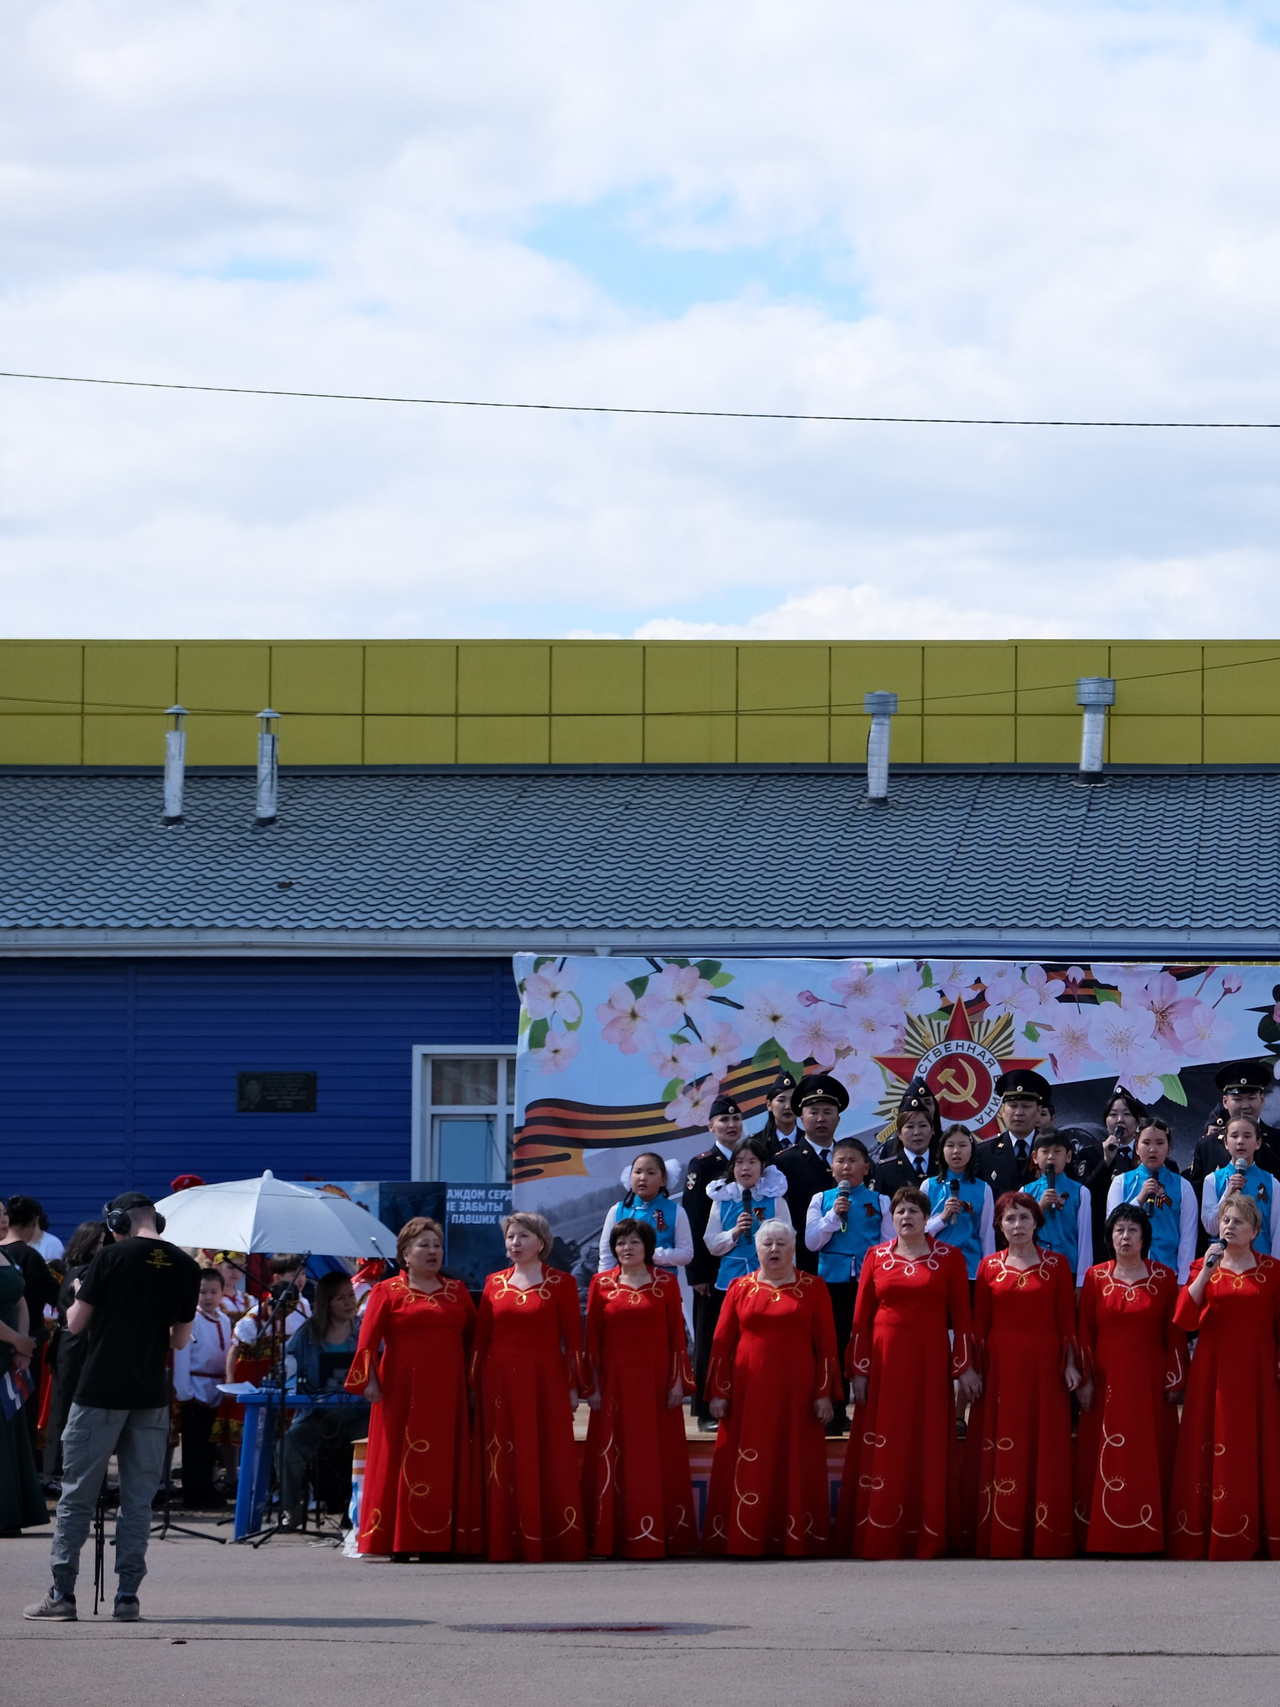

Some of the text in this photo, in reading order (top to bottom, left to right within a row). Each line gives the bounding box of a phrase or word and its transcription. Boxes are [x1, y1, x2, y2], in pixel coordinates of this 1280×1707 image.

[917, 1041, 1003, 1125] СТВЕННАЯ ВЙНА
[446, 1188, 513, 1201] АЖДОМ СЕРД
[458, 1201, 504, 1212] ЗАБЫТЫ
[451, 1213, 496, 1224] ПАВШИХ
